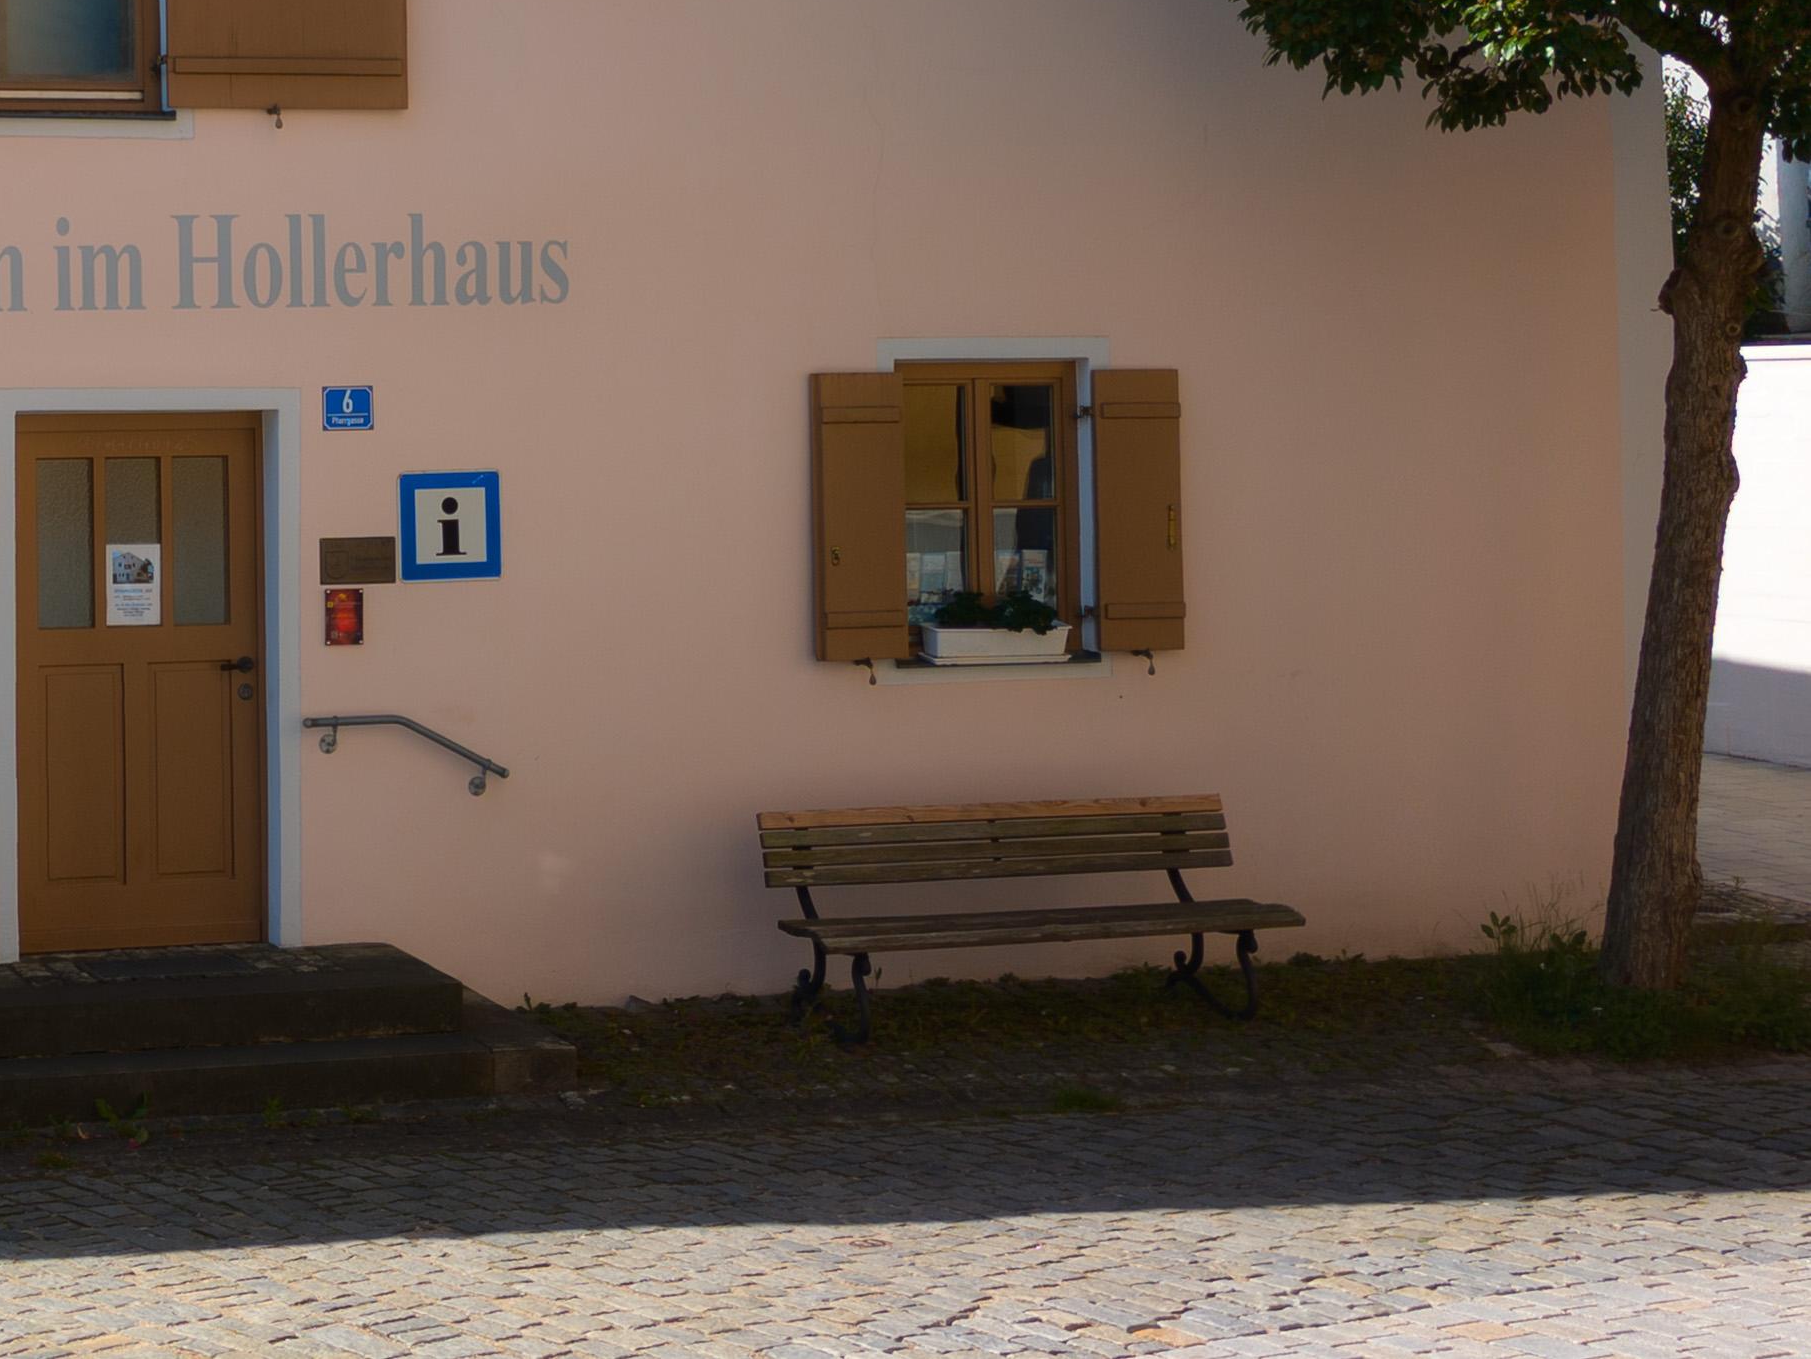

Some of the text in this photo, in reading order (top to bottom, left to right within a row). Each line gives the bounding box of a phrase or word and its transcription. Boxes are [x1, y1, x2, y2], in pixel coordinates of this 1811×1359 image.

[53, 217, 147, 312] im
[170, 213, 570, 310] Hollerhaus
[342, 389, 353, 413] 6
[436, 497, 467, 556] i
